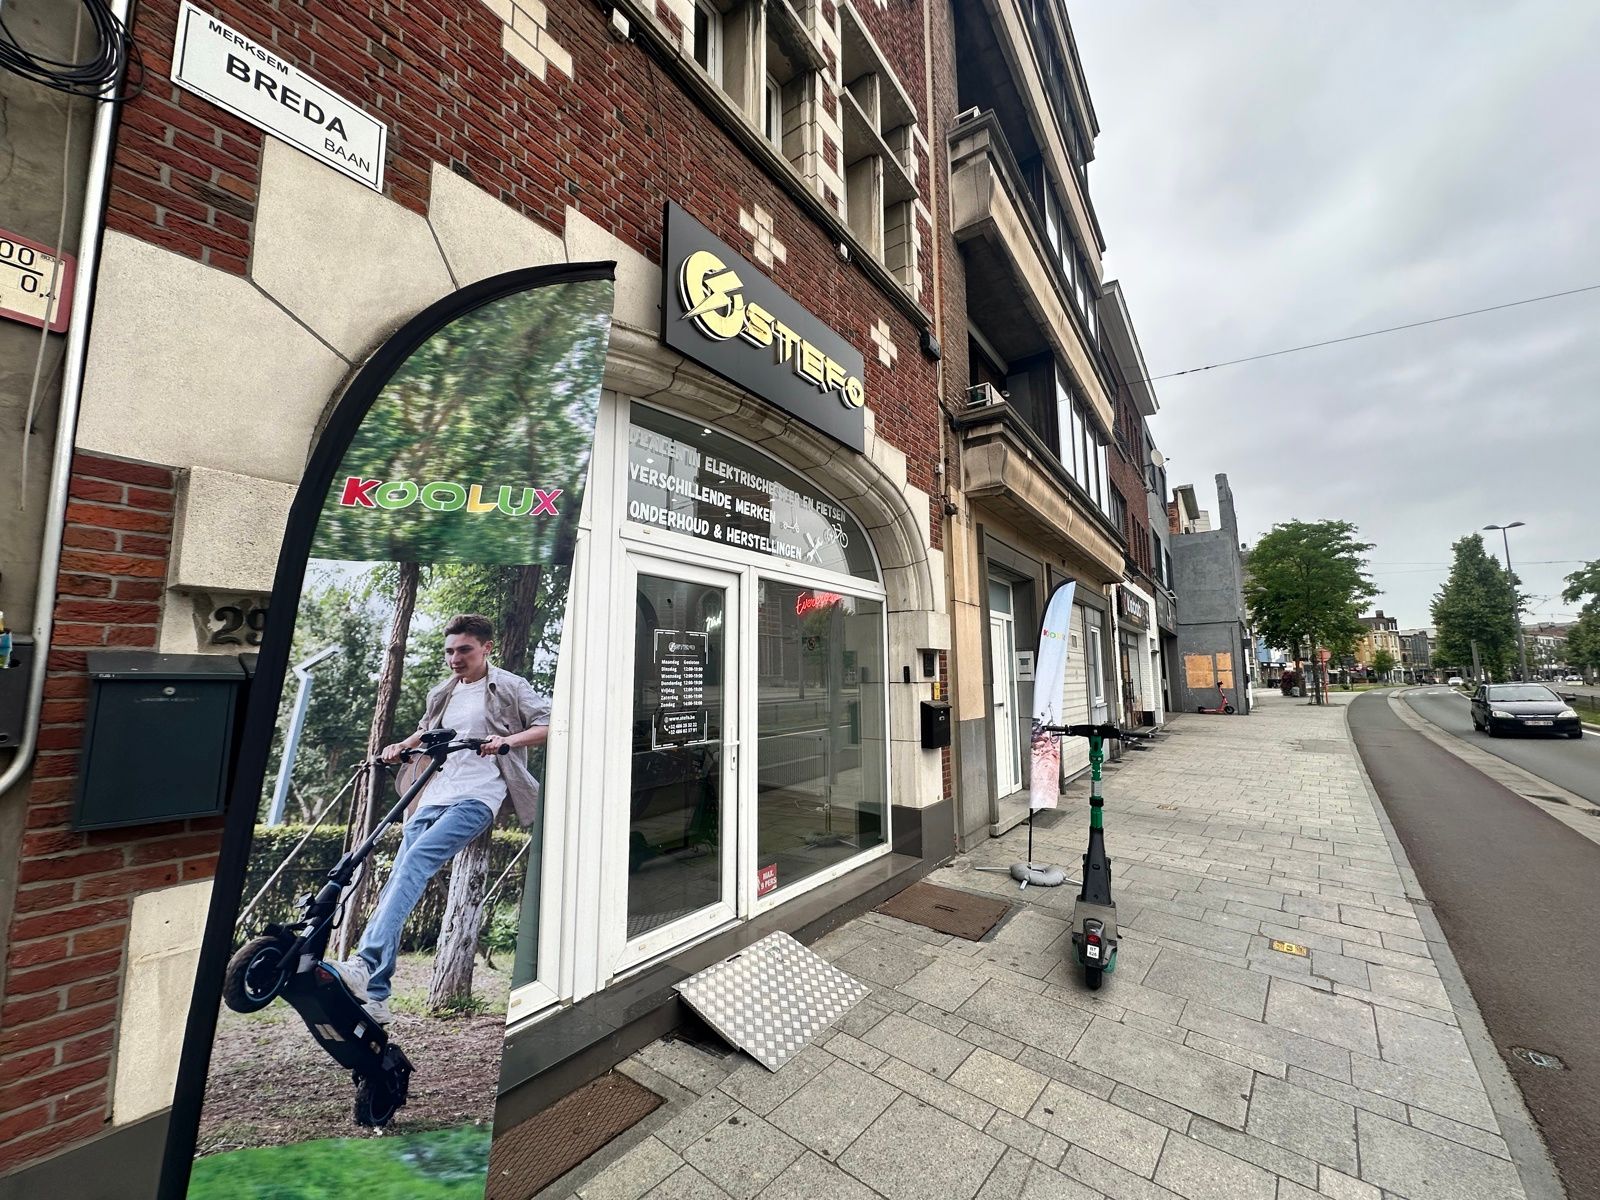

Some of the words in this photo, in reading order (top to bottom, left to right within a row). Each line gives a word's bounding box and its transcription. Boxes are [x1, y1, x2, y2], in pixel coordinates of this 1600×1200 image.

[208, 20, 289, 76] MERKSEM
[225, 53, 348, 141] BREDA
[324, 137, 371, 173] BAAN
[339, 476, 564, 516] KOOLUX
[629, 462, 732, 511] VERSCHILLENDE
[735, 495, 776, 524] MERKEN
[704, 456, 775, 496] ELEKTRISCHE
[816, 500, 846, 523] FIETSEN
[629, 500, 710, 536] ONDERHOUD
[713, 525, 723, 540] &
[726, 527, 802, 560] HERSTELLINGEN
